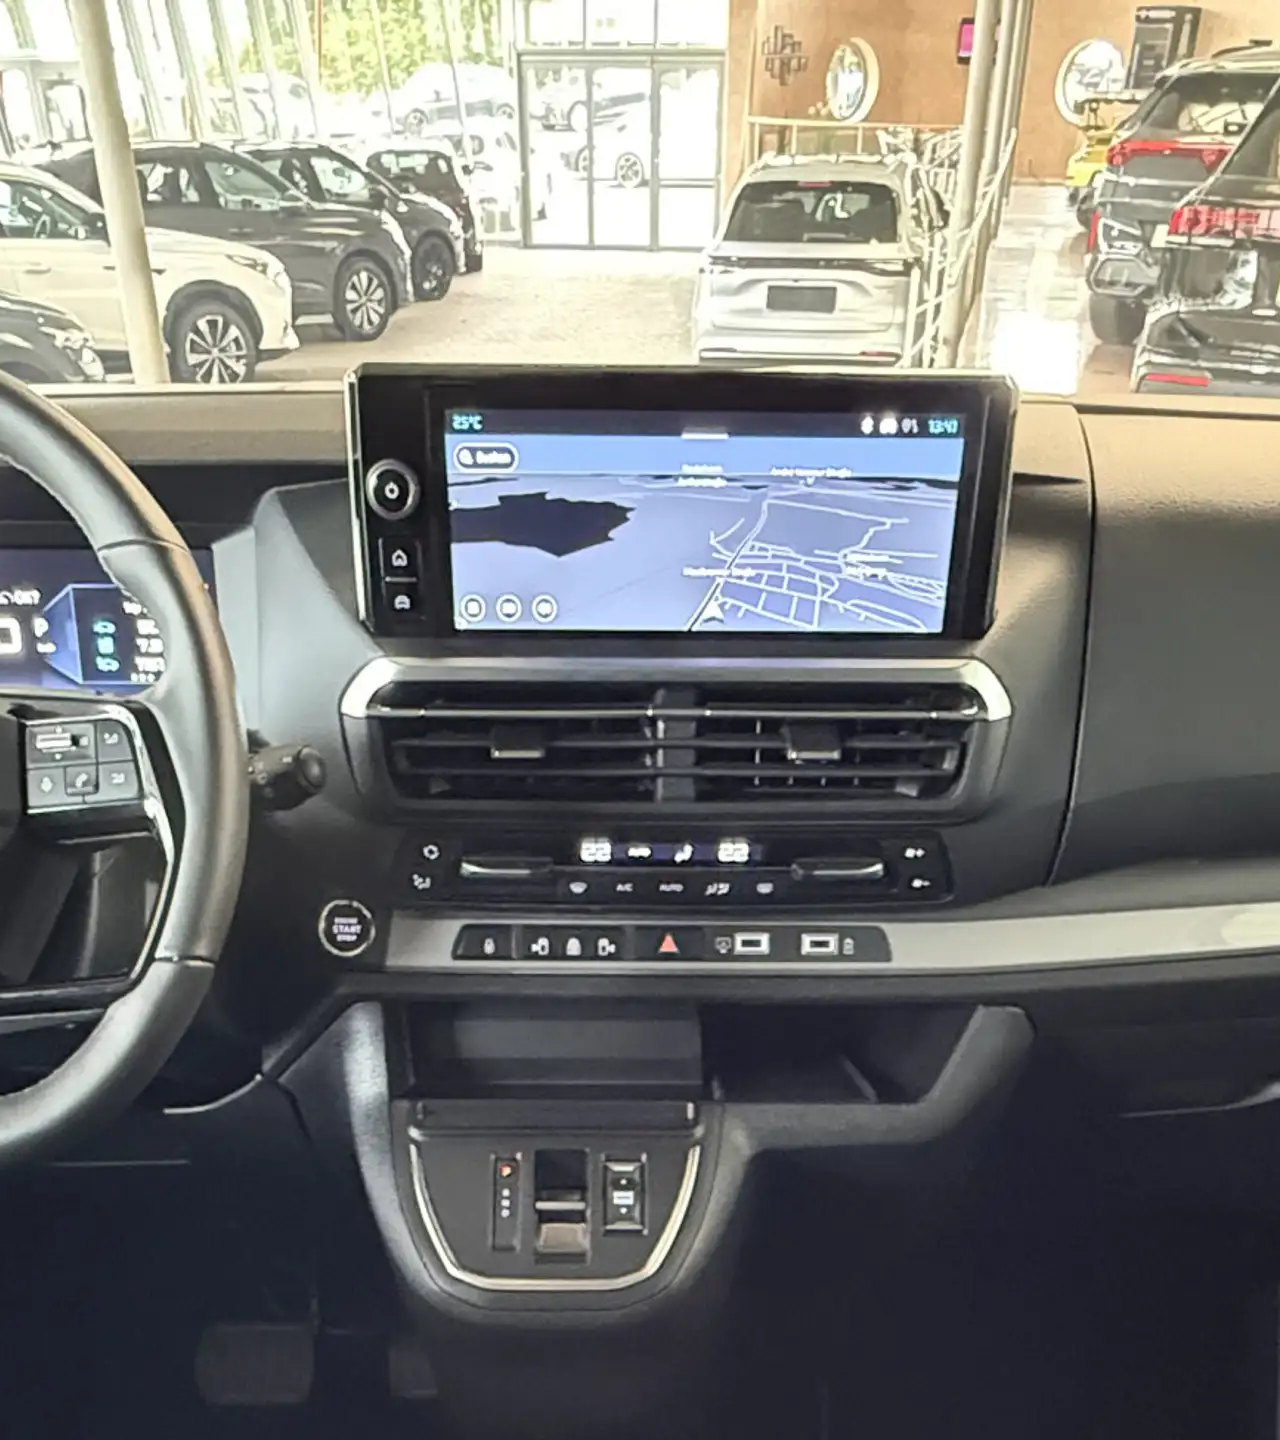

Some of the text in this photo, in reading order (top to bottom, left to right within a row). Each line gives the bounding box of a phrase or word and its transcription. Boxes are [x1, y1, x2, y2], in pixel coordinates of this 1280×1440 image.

[581, 838, 612, 862] 22
[718, 840, 750, 862] 22
[332, 924, 362, 934] START
